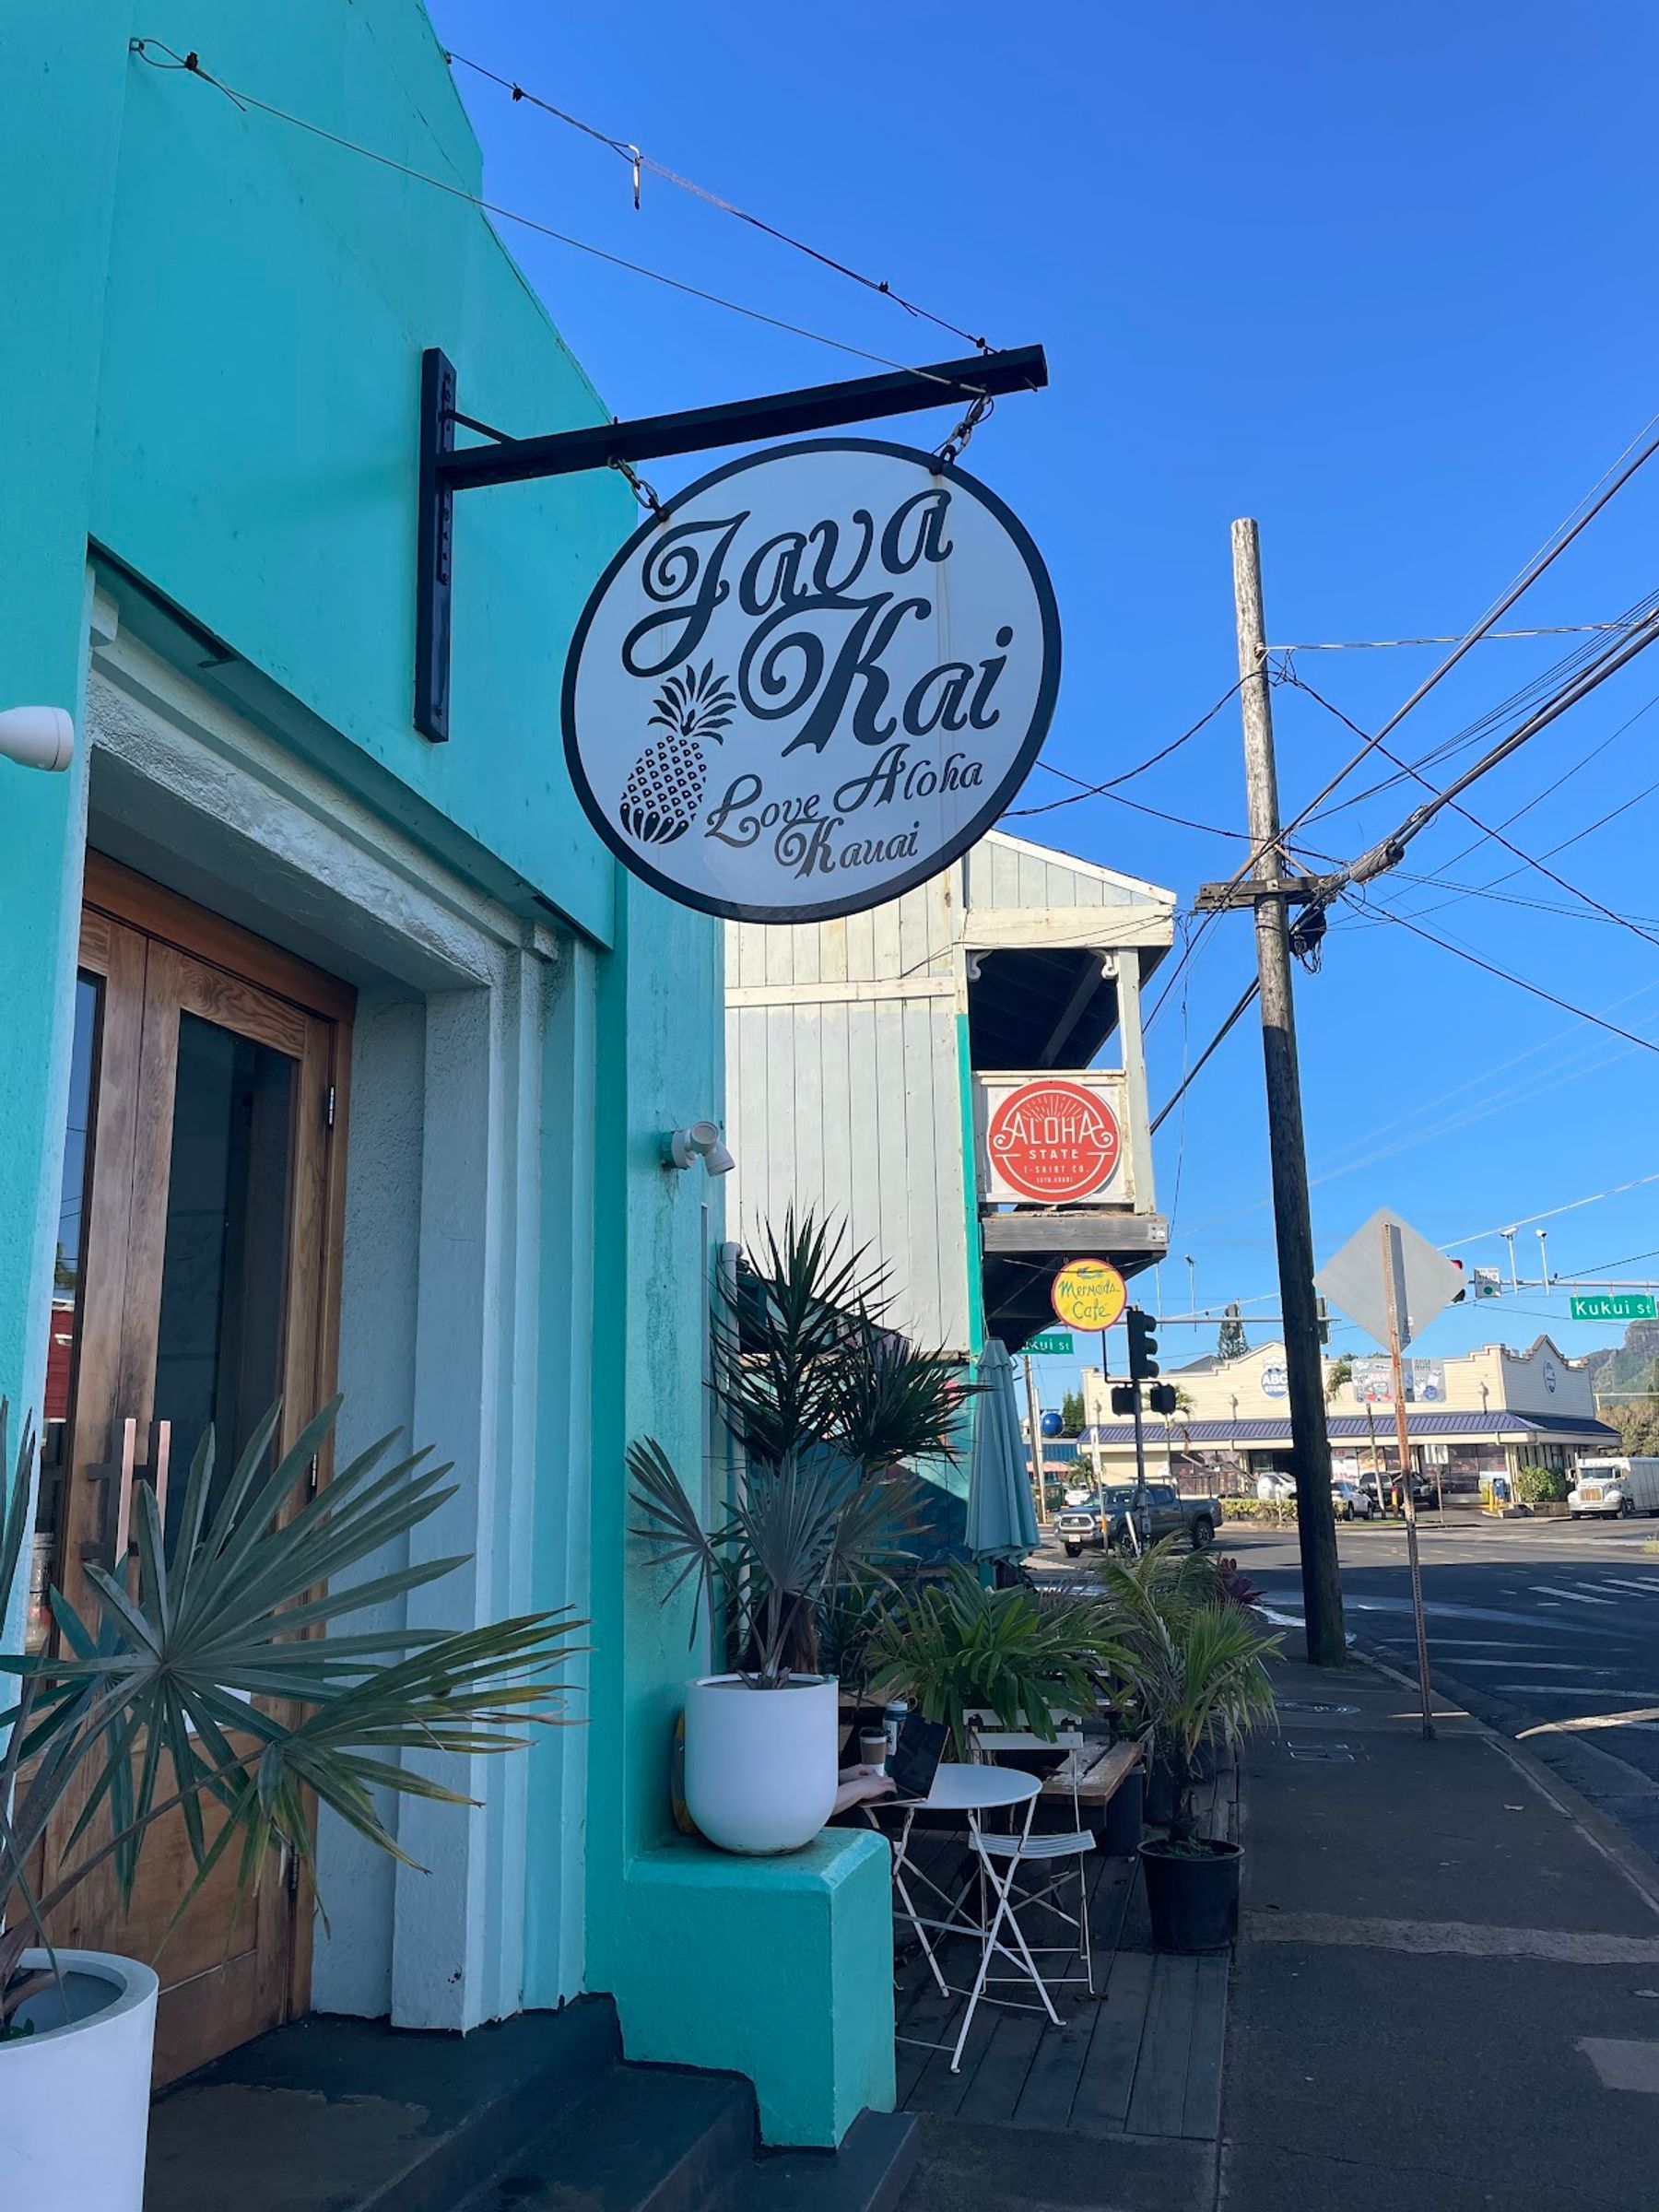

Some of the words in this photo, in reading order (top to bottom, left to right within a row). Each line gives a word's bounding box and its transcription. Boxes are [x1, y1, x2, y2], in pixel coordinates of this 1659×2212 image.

[622, 488, 953, 677] Java
[738, 592, 1013, 757] Kai
[704, 774, 820, 848] Love
[833, 743, 982, 812] Aloha
[774, 816, 919, 879] Kauai
[993, 1110, 1113, 1150] ALOHA
[1029, 1148, 1079, 1159] STATE
[1023, 1165, 1065, 1173] T-SHIRT
[1575, 1300, 1630, 1316] Kukui
[1021, 1338, 1053, 1350] ukui
[1262, 1370, 1288, 1384] ABC
